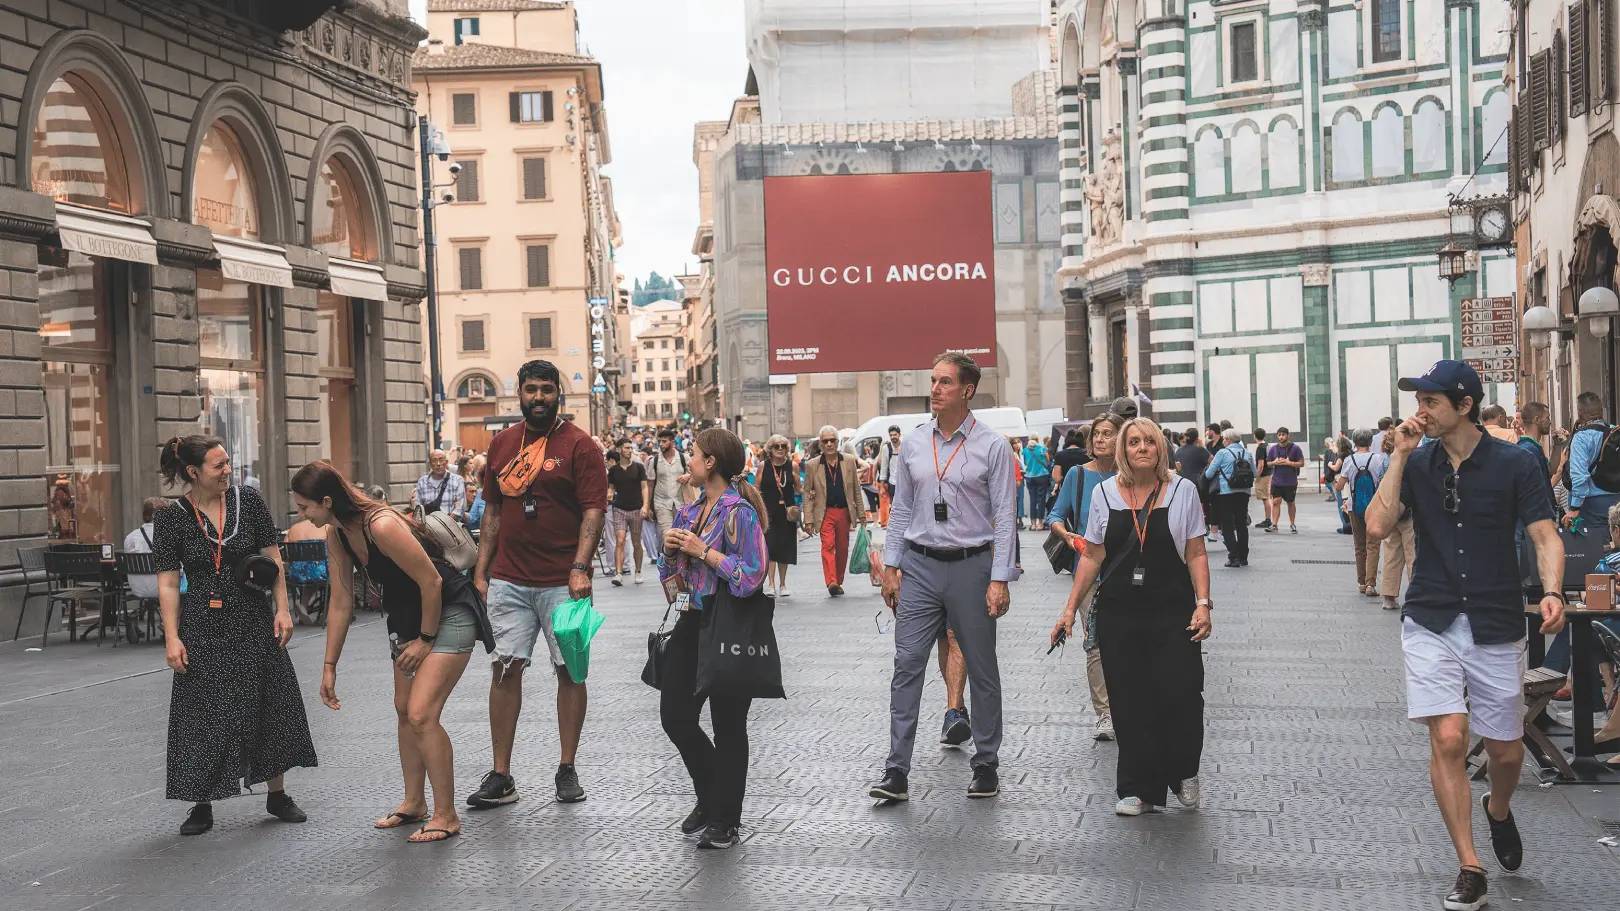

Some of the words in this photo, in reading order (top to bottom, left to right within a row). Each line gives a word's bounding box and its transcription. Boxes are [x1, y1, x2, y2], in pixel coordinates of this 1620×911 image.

[773, 266, 872, 286] GUCCI
[886, 262, 987, 282] ANCORA
[720, 642, 769, 657] ICON
